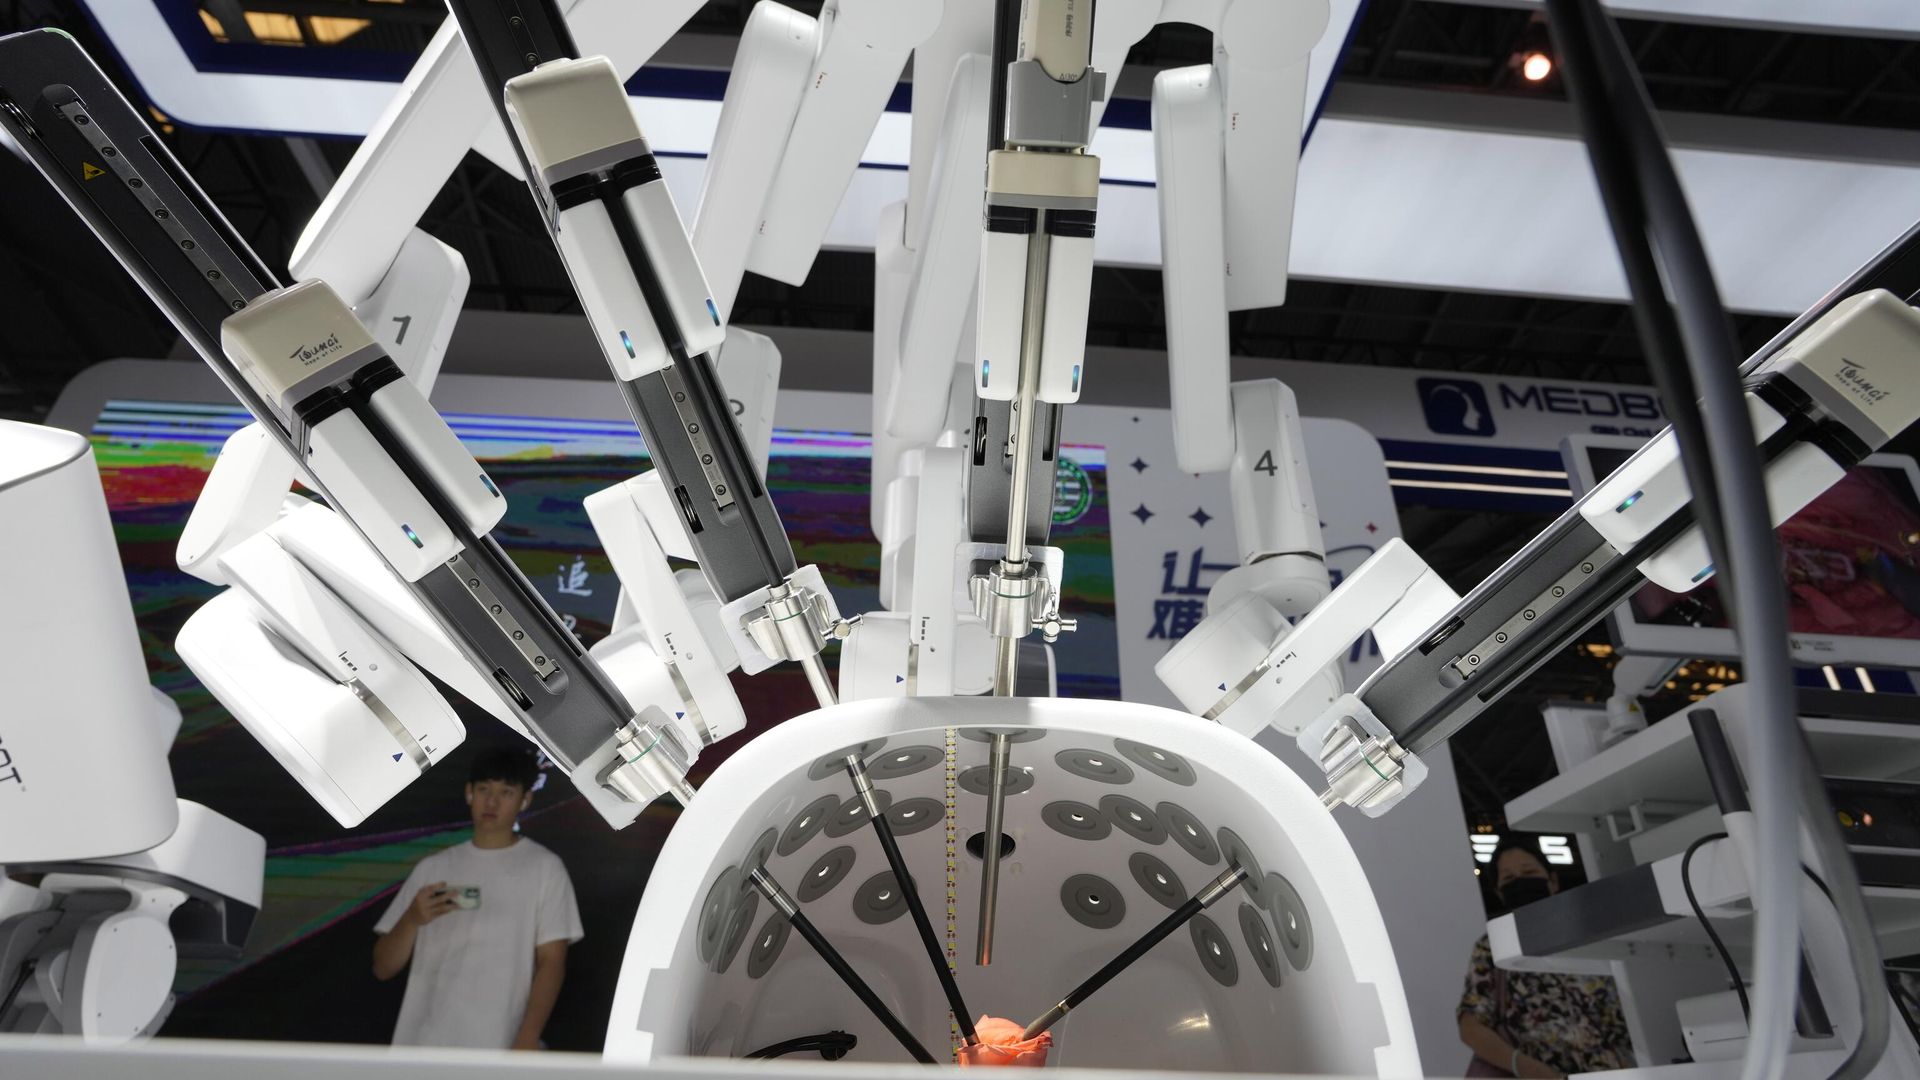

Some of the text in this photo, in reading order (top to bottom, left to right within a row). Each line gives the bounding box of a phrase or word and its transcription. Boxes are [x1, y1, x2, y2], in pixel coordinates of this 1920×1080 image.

[392, 315, 411, 345] 1
[1498, 383, 1673, 420] MEDB
[1254, 450, 1278, 476] 4
[557, 554, 593, 597] 追
